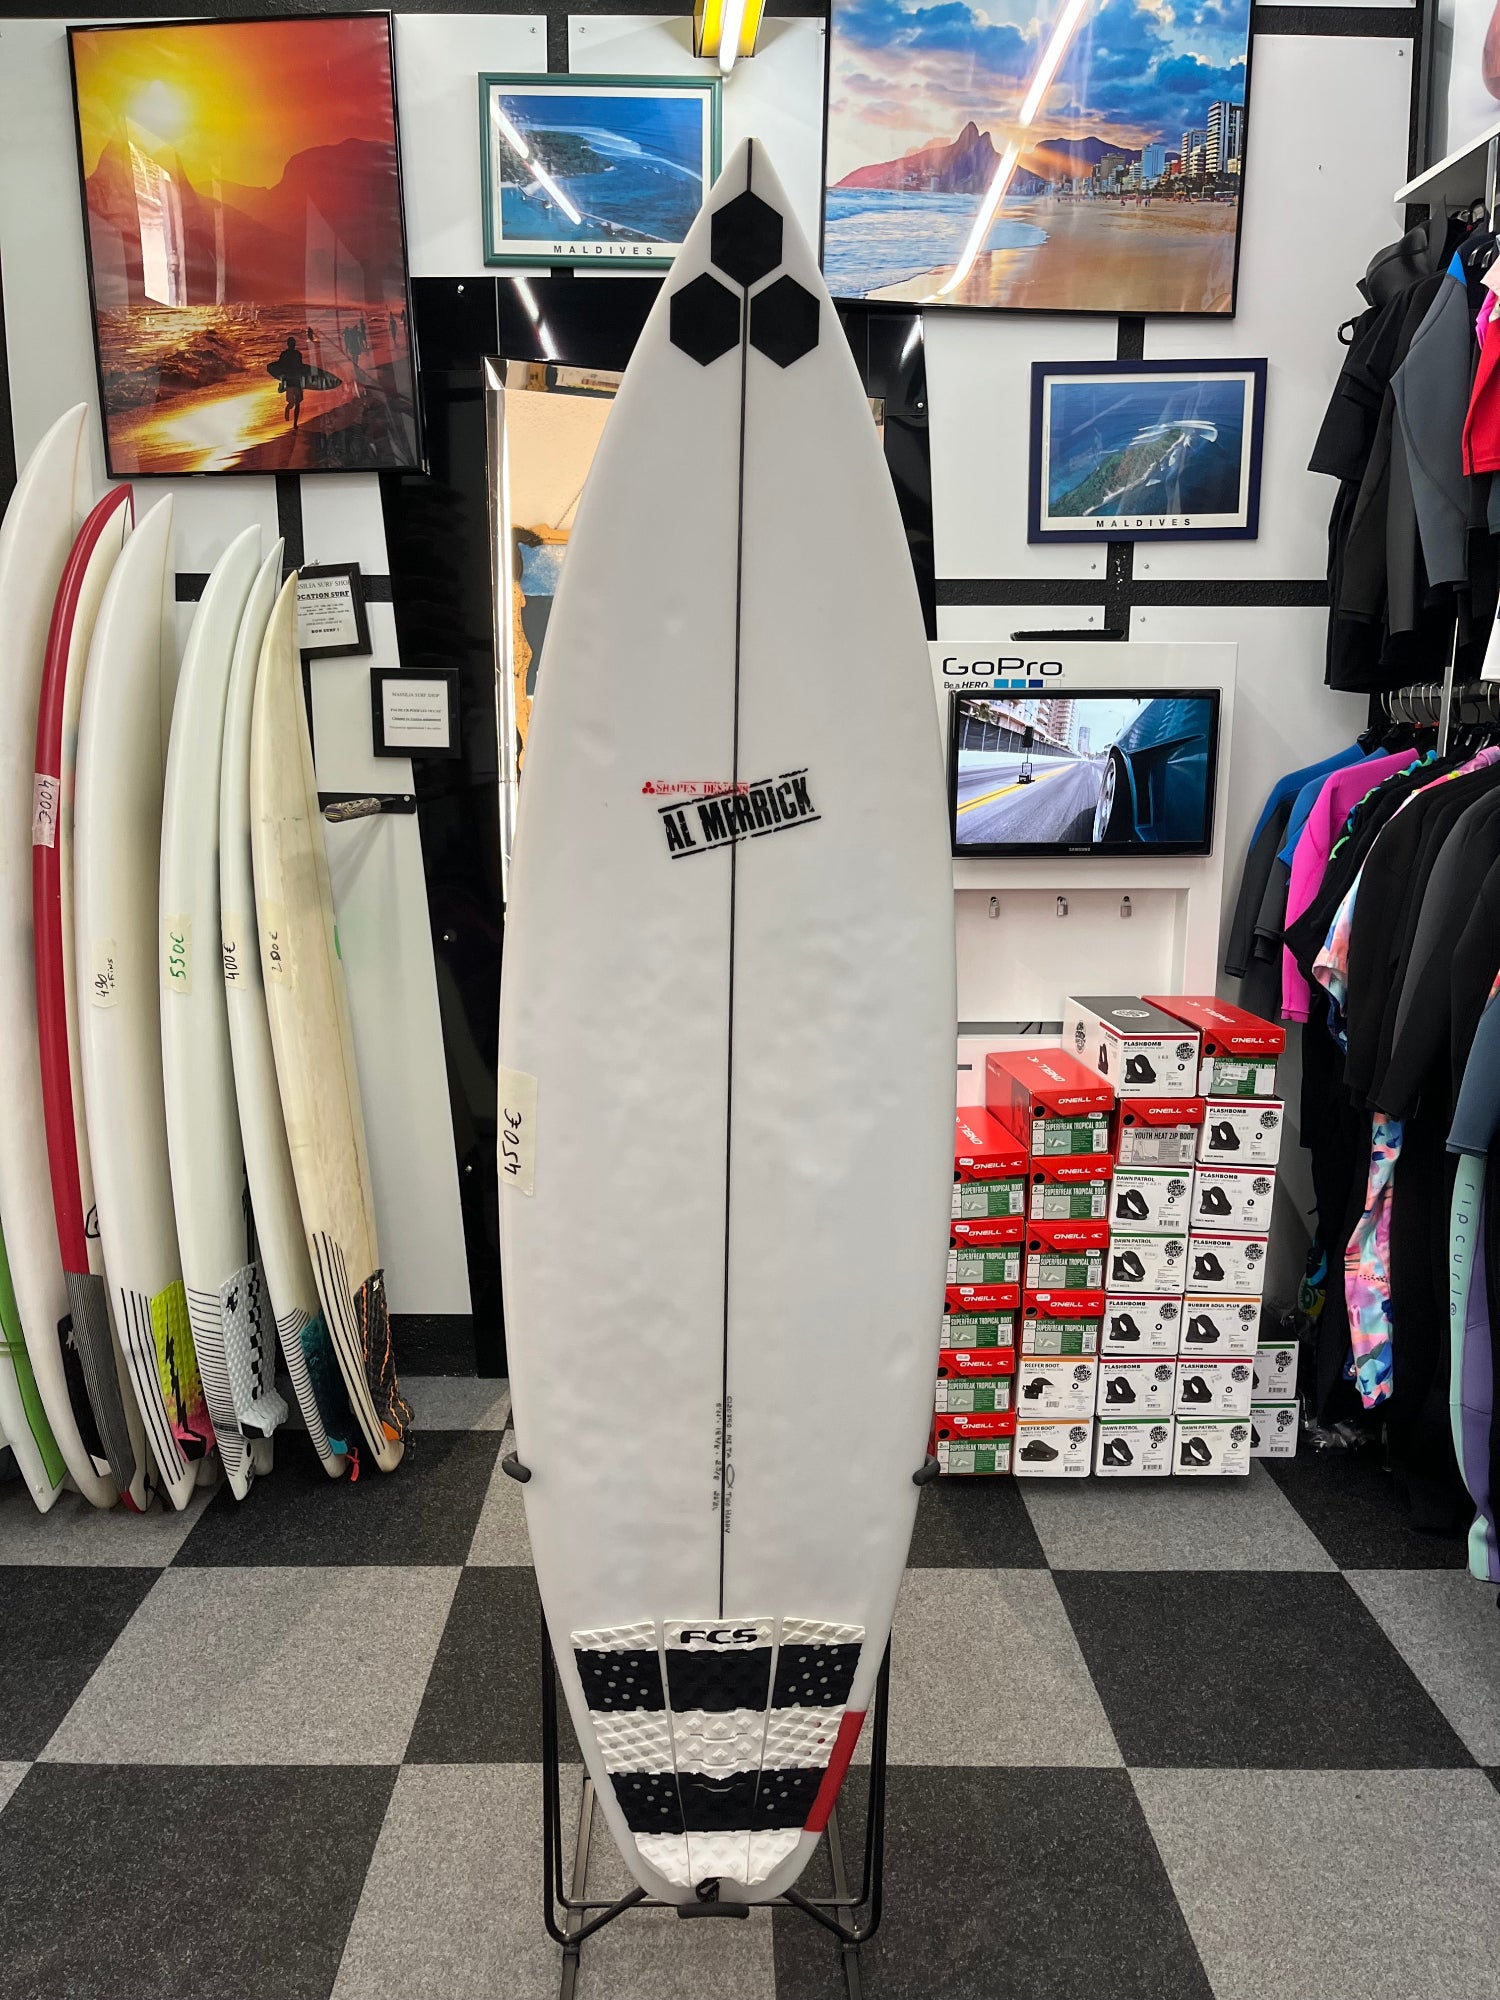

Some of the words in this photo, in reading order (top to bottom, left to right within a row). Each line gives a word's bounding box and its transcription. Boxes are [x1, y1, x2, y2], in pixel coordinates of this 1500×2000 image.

[553, 245, 653, 255] MALDIVES
[1096, 518, 1191, 528] MALDIVES
[942, 657, 1063, 676] GoPro
[656, 783, 697, 794] SHAPES
[663, 810, 697, 851] AL
[697, 776, 815, 842] MERRICK
[169, 931, 187, 980] 550€
[223, 941, 240, 980] 400€
[501, 1107, 522, 1175] 450€
[1154, 1132, 1168, 1140] HEAT
[1168, 1132, 1179, 1140] ZIP
[1179, 1132, 1195, 1140] BOOT
[973, 1161, 1006, 1170] O'NEILL
[1451, 1183, 1475, 1296] ripcurl
[680, 1628, 758, 1645] FCS
